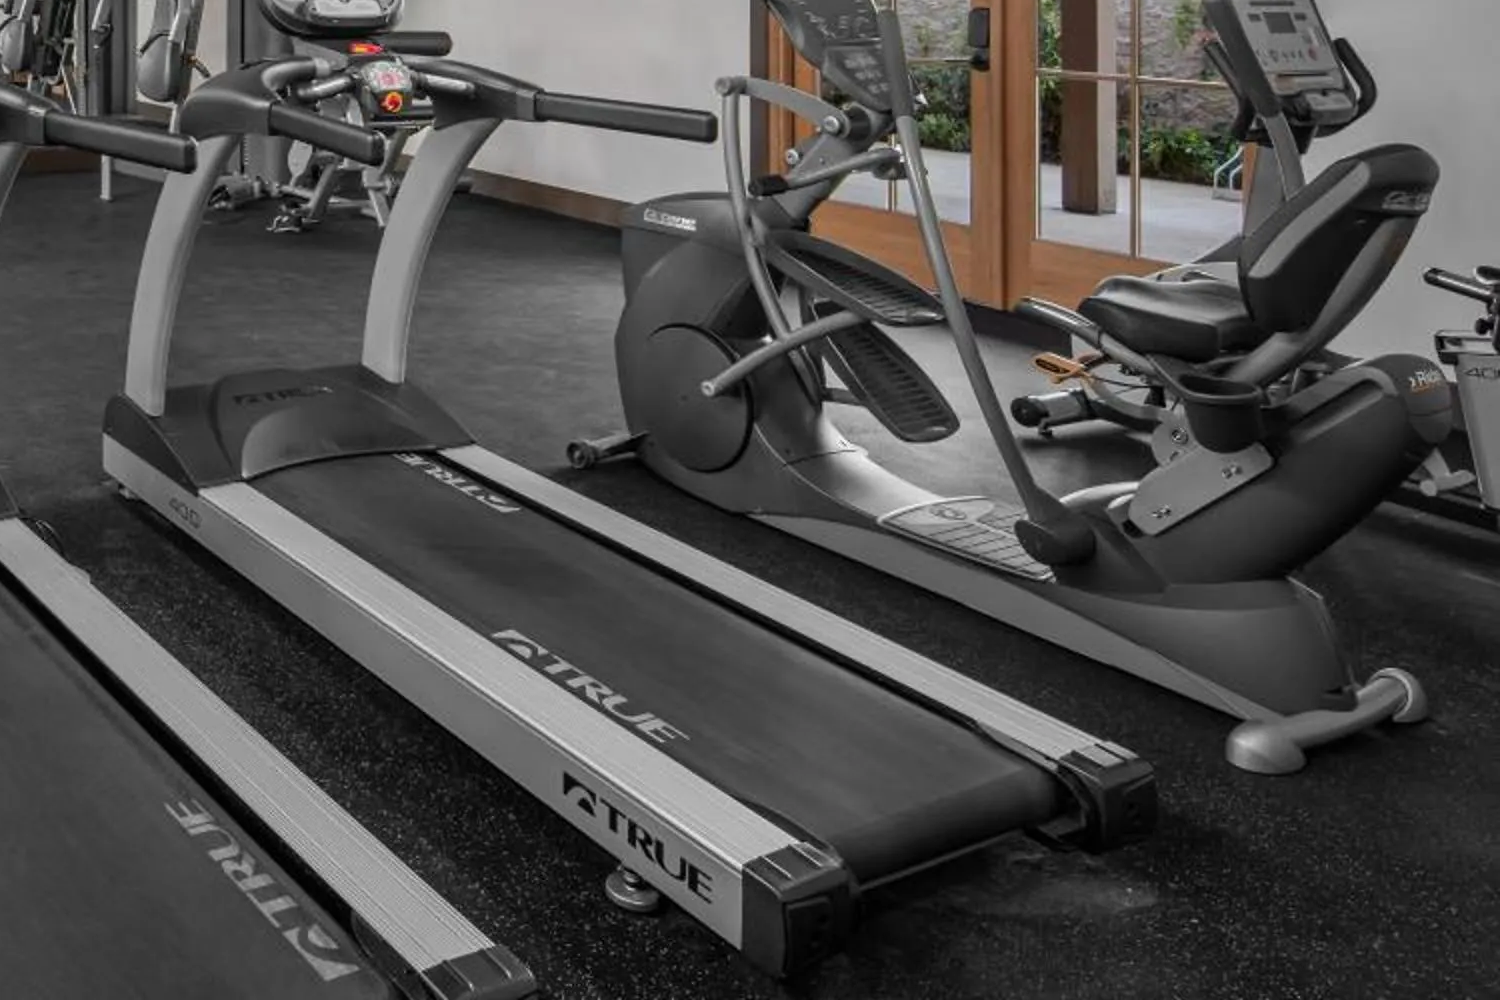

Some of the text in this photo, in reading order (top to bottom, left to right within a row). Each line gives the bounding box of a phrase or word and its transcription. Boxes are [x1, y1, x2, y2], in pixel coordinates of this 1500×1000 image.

[543, 653, 692, 744] TRUE
[164, 799, 299, 929] TRUE
[599, 797, 714, 905] TRUE
